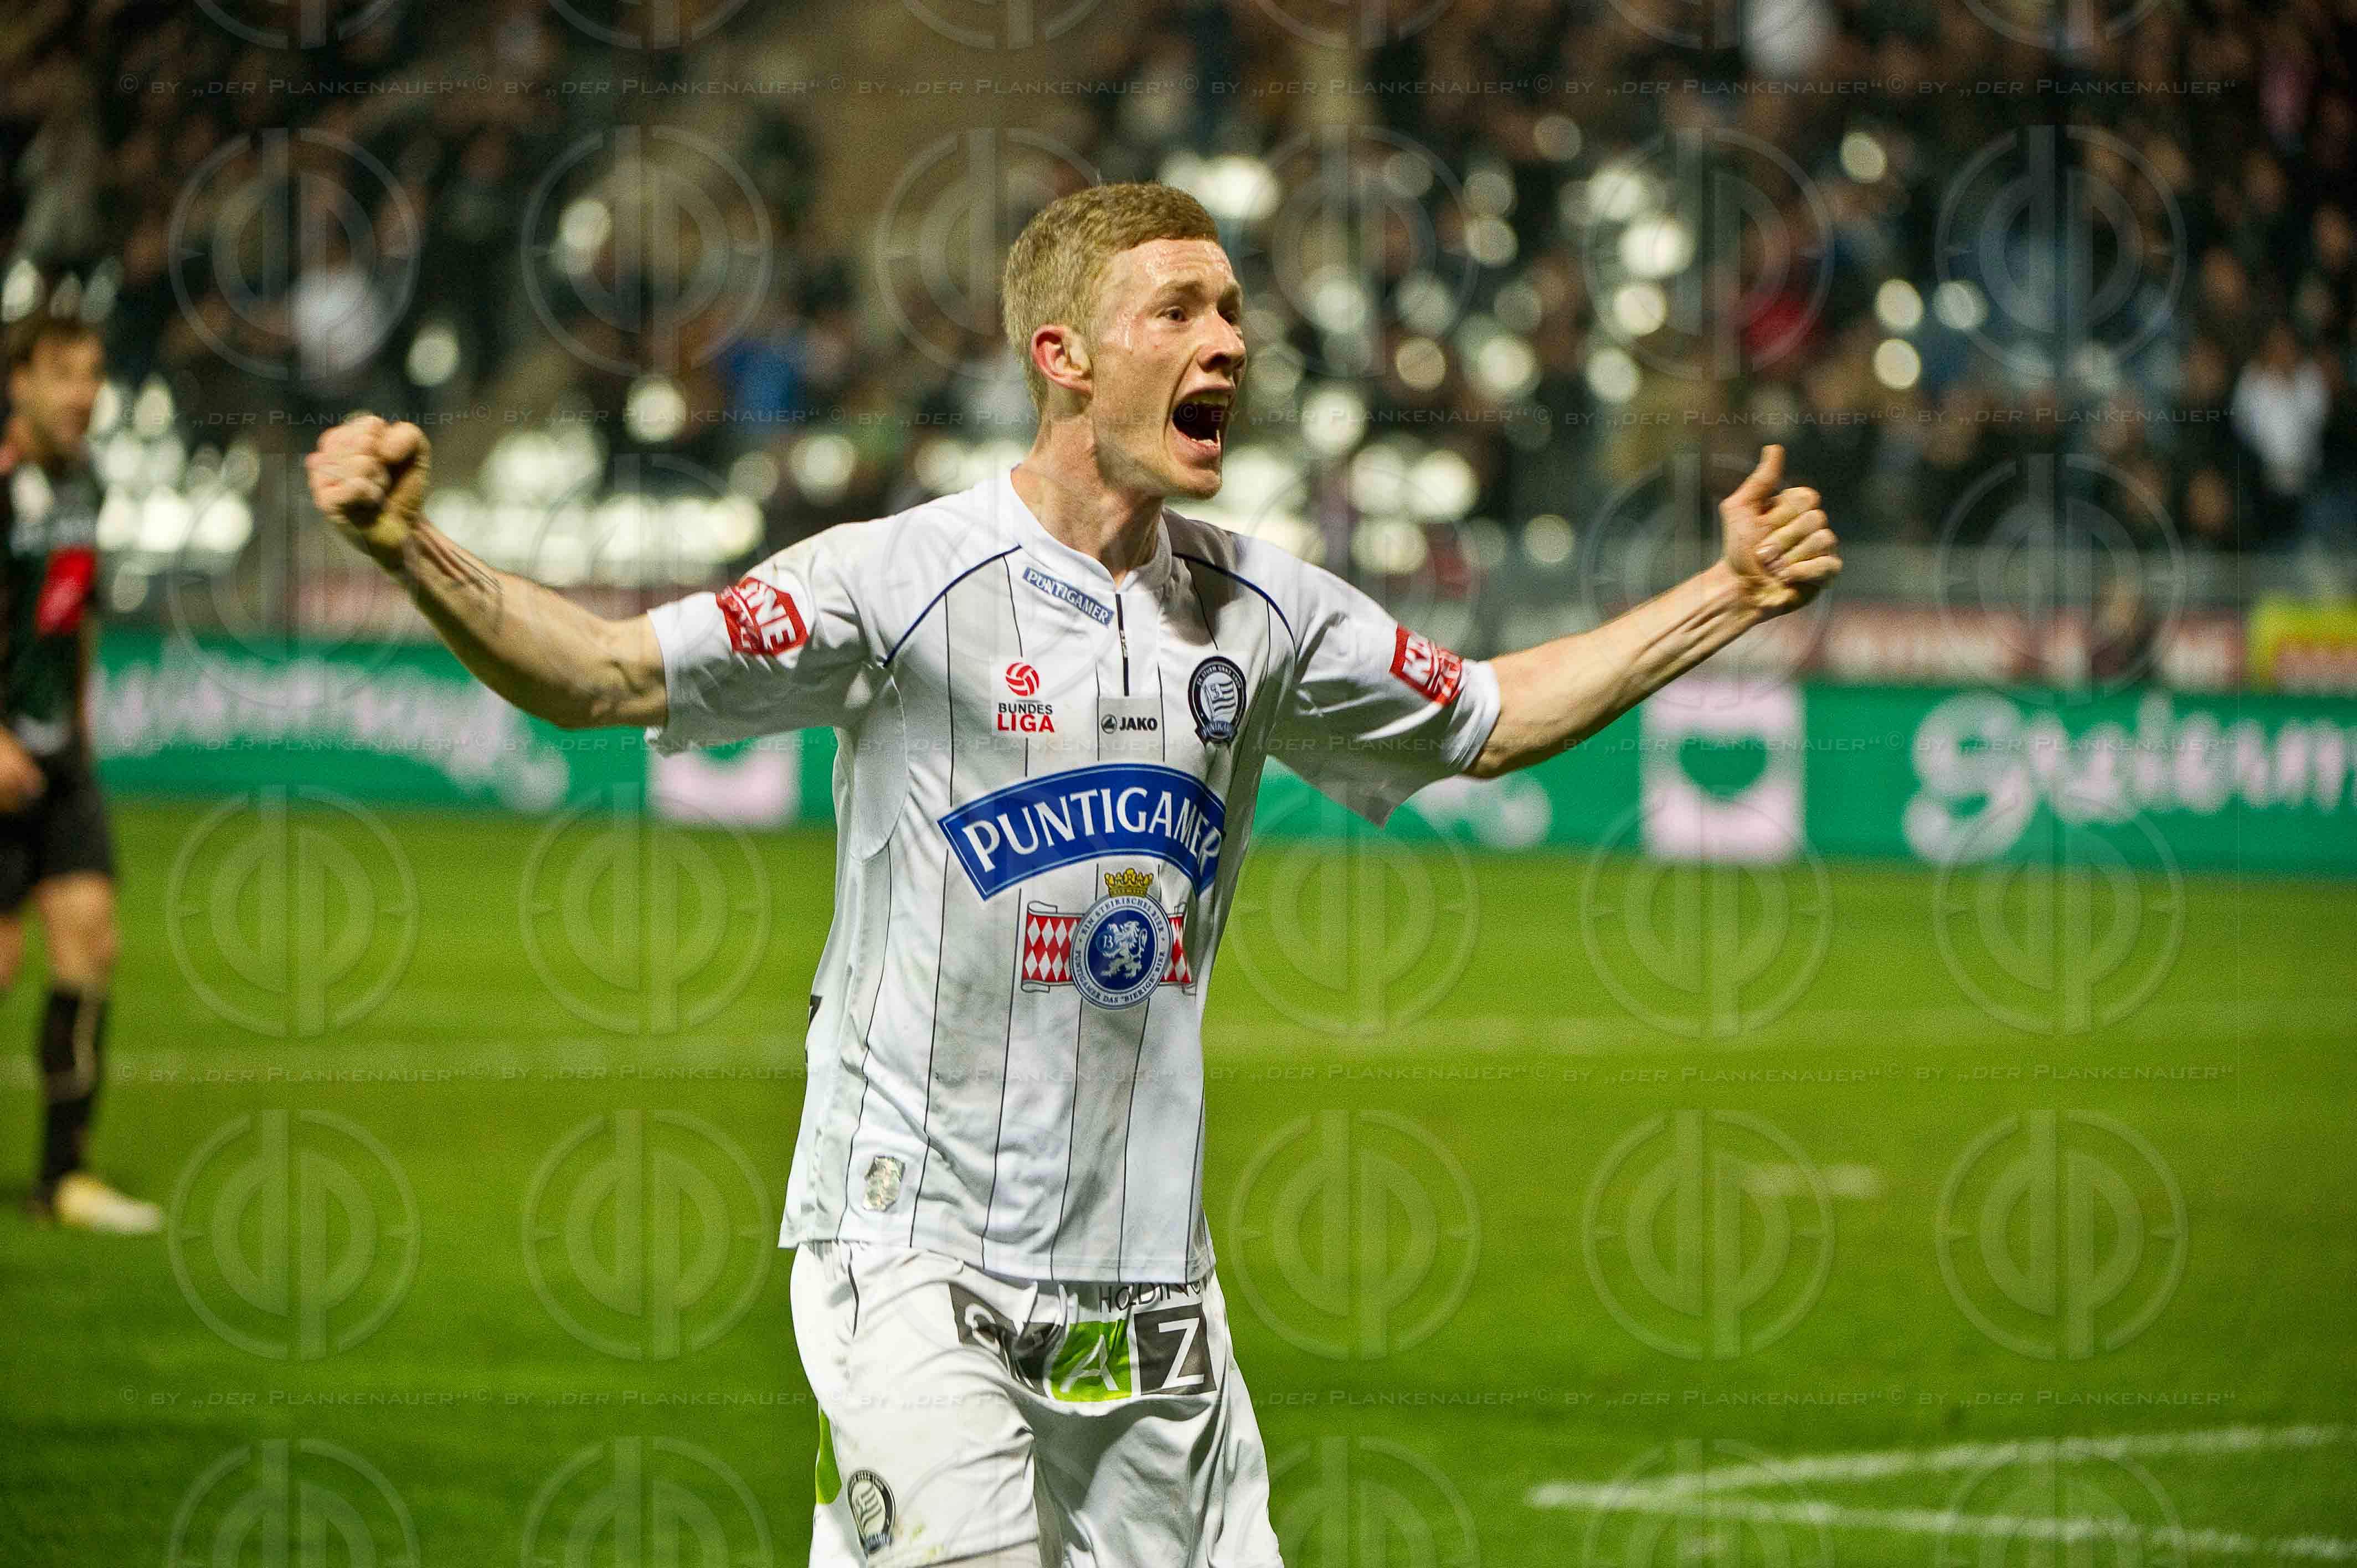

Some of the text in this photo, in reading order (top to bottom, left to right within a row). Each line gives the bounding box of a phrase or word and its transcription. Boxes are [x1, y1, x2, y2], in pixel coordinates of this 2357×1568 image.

[1027, 568, 1109, 623] PUNTIGAMER
[998, 702, 1053, 715] BUNDES
[997, 714, 1055, 734] LIGA
[1119, 717, 1159, 731] JAKO
[961, 787, 1222, 876] PUNTIGAMER
